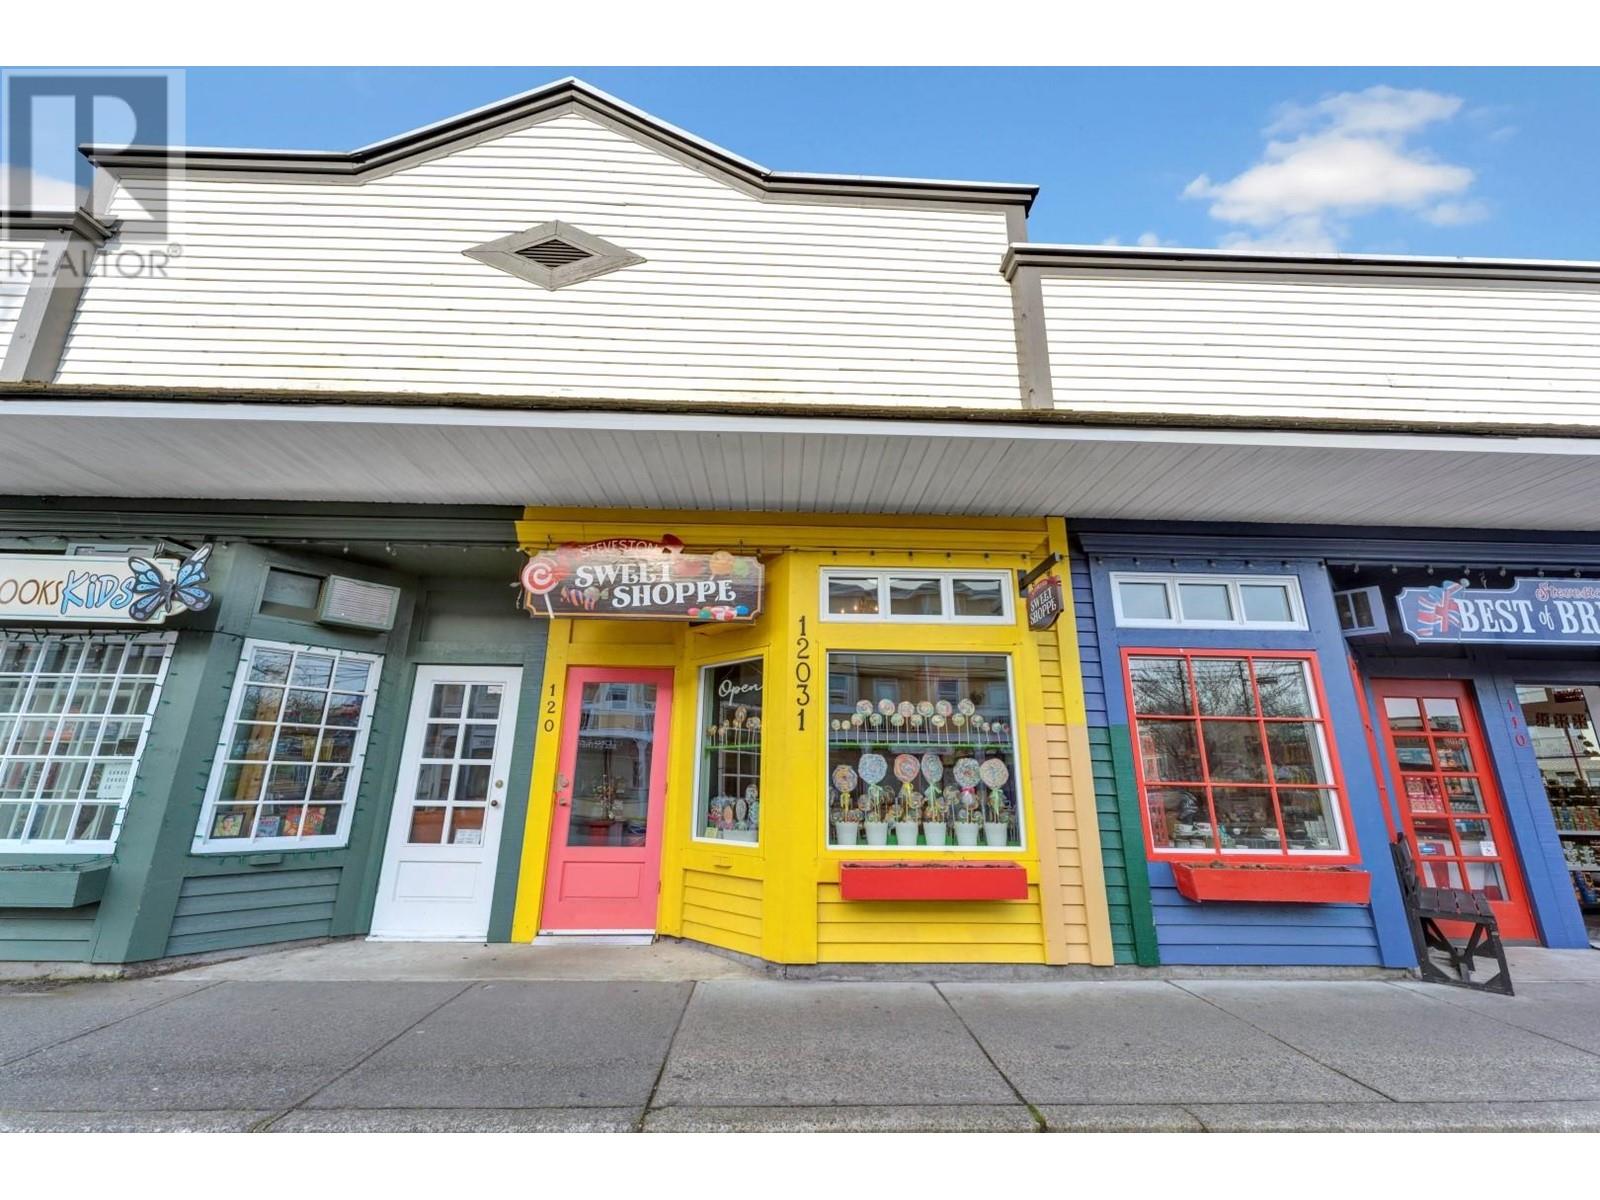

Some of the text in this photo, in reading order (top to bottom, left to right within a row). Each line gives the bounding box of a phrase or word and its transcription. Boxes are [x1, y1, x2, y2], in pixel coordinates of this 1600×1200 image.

[575, 561, 675, 587] SWEET
[612, 579, 737, 608] SHOPPE
[1030, 586, 1052, 612] SWEET
[1030, 597, 1057, 625] SHOPPE
[1455, 599, 1600, 635] BEST of BR
[795, 615, 811, 731] 12031
[718, 680, 764, 706] Open
[544, 684, 556, 732] 120
